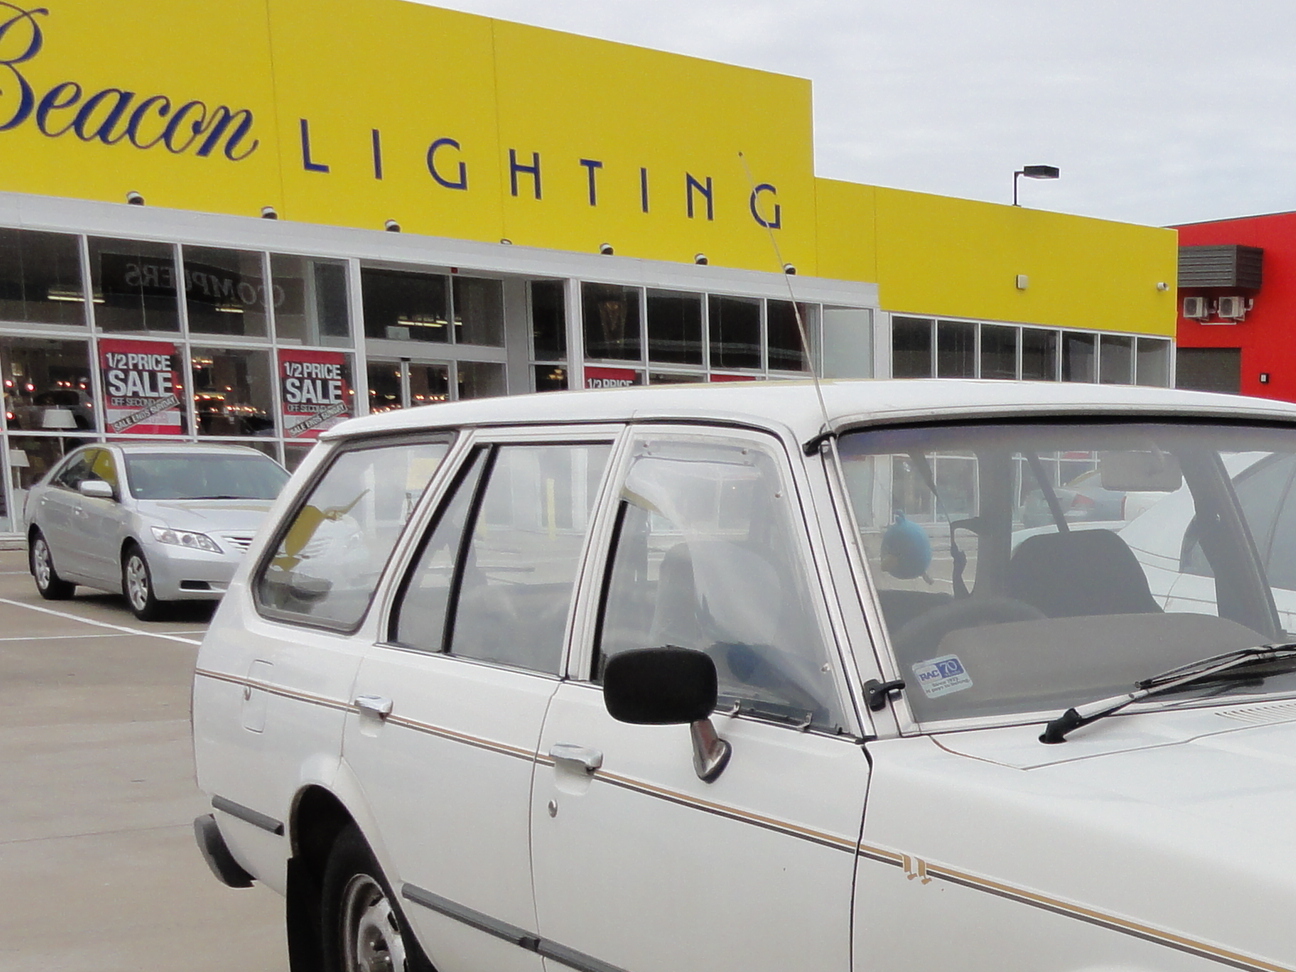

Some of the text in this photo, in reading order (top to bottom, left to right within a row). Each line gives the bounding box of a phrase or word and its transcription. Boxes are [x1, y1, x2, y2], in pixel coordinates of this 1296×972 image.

[0, 1, 782, 230] Beacon LIGHTING
[105, 352, 172, 371] 1/2 PRICE
[283, 361, 342, 379] 1/2 PRICE
[108, 369, 174, 398] SALE
[285, 377, 343, 405] SALE
[113, 417, 133, 431] SALE
[939, 660, 958, 676] 70
